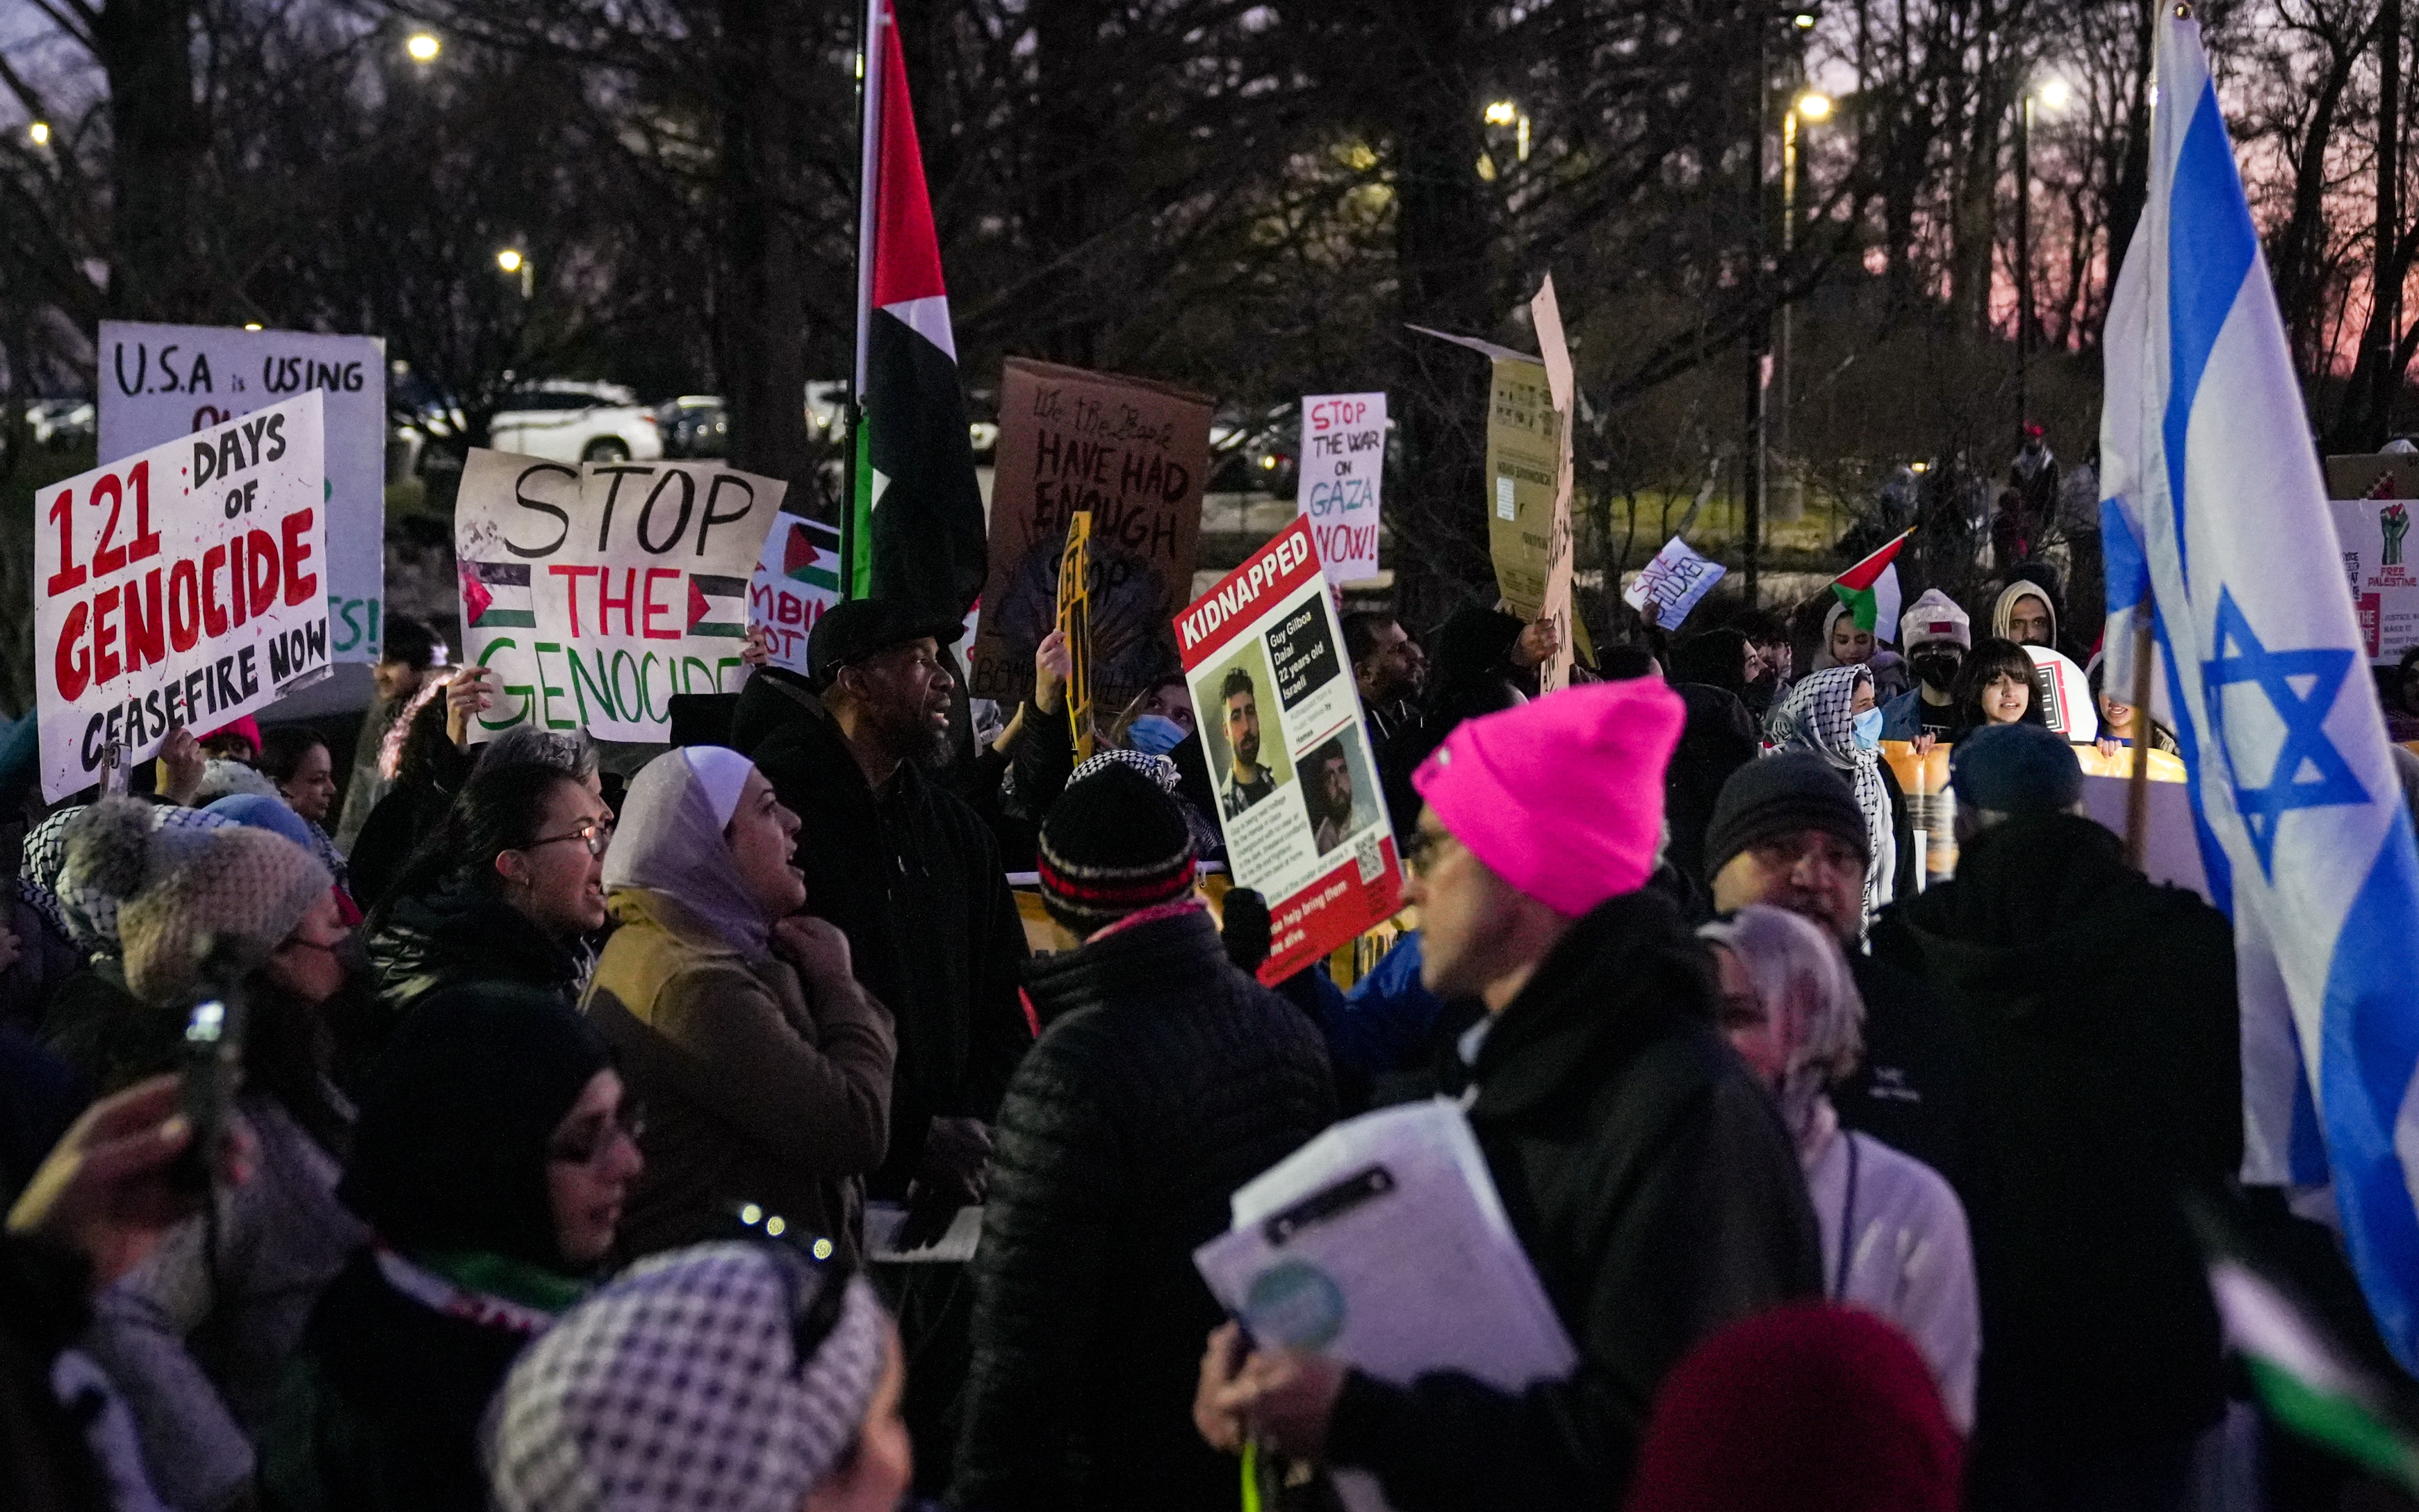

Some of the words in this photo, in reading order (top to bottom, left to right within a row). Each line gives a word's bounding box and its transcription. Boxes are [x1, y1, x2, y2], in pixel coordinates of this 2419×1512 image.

[115, 342, 213, 395] U.S.A
[231, 375, 245, 392] is
[264, 356, 364, 393] USING
[1311, 401, 1366, 431] STOP
[193, 412, 286, 490] DAYS
[1034, 428, 1115, 485] HAVE
[1121, 452, 1189, 502] HAD
[1313, 432, 1343, 458] THE
[1347, 430, 1380, 452] WAR
[1334, 461, 1352, 477] ON
[225, 479, 258, 520] OF
[505, 463, 755, 559] STOP
[1310, 477, 1374, 517] GAZA
[48, 459, 163, 598] 121
[1316, 524, 1376, 564] NOW!
[1042, 553, 1131, 607] SOP
[1181, 531, 1310, 650] KIDNAPPED
[1633, 550, 1678, 600] SAVE
[2368, 577, 2417, 587] PALESTINE
[2381, 566, 2405, 577] FREE
[55, 507, 318, 703] GENOCIDE
[549, 564, 681, 640] THE
[1270, 630, 1286, 648] Guy
[1286, 610, 1312, 636] Gilboa
[1274, 643, 1293, 666] Dalal
[1278, 669, 1289, 684] 22
[1289, 654, 1311, 680] years
[1311, 641, 1325, 658] old
[81, 644, 259, 773] CEASEFIRE
[270, 616, 327, 686] NOW
[1283, 675, 1307, 701] Israeli
